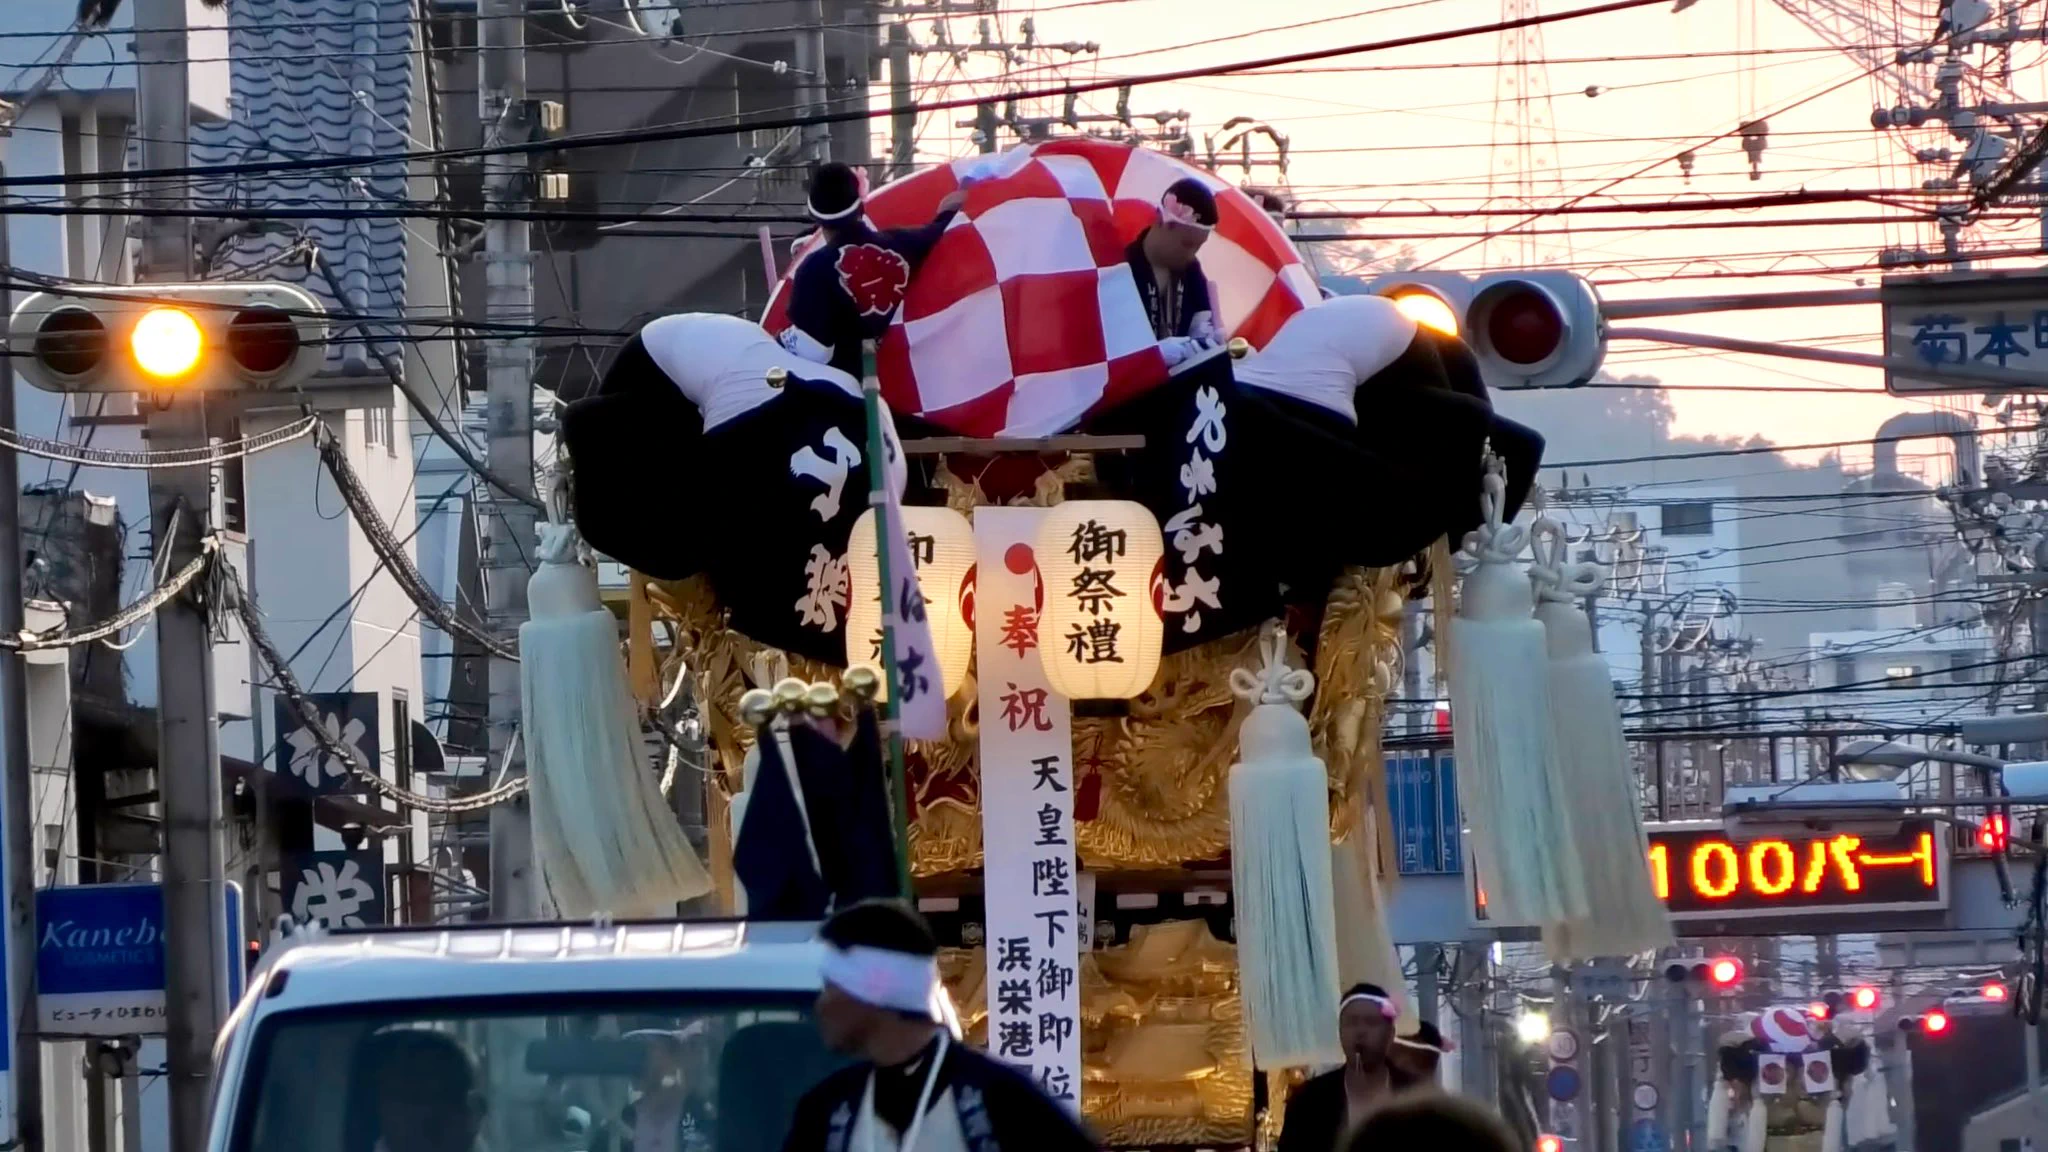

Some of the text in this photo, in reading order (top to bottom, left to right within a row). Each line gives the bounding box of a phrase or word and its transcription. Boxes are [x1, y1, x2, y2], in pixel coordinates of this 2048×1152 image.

[1064, 518, 1127, 664] 御祭禮
[997, 603, 1054, 733] 奉祝
[40, 917, 167, 949] Kaneb
[1030, 754, 1076, 1101] 天皇陛下御即位
